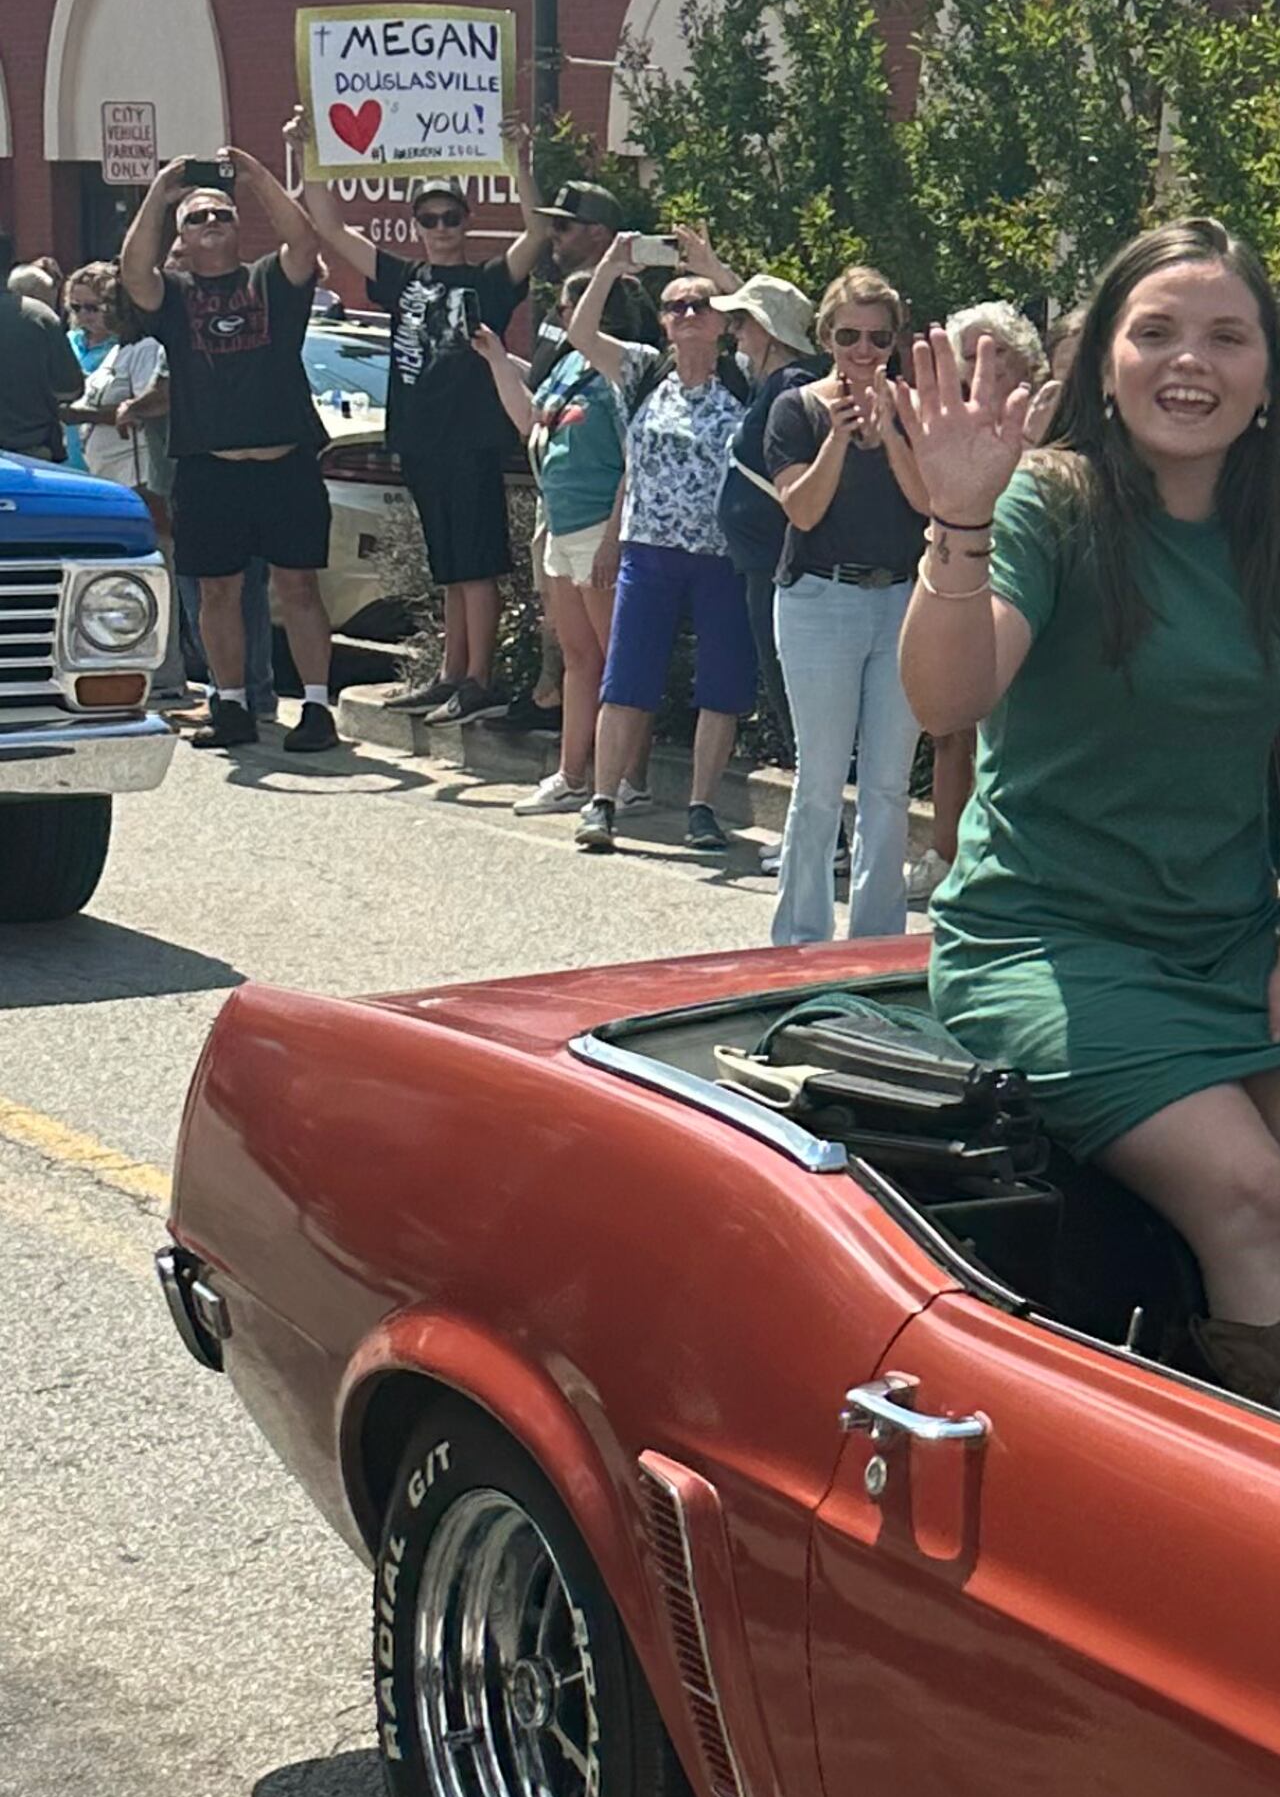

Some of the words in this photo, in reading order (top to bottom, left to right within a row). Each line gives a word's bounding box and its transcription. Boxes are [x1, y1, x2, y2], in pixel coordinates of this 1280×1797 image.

[340, 21, 498, 61] MEGAN
[335, 69, 500, 94] DOUGLASVILLE
[112, 106, 145, 123] CITY
[107, 124, 151, 141] VEHICLE
[107, 143, 154, 160] PARKING
[111, 162, 150, 179] ONLY
[371, 218, 421, 244] GEOR
[378, 1534, 407, 1761] RADIAL
